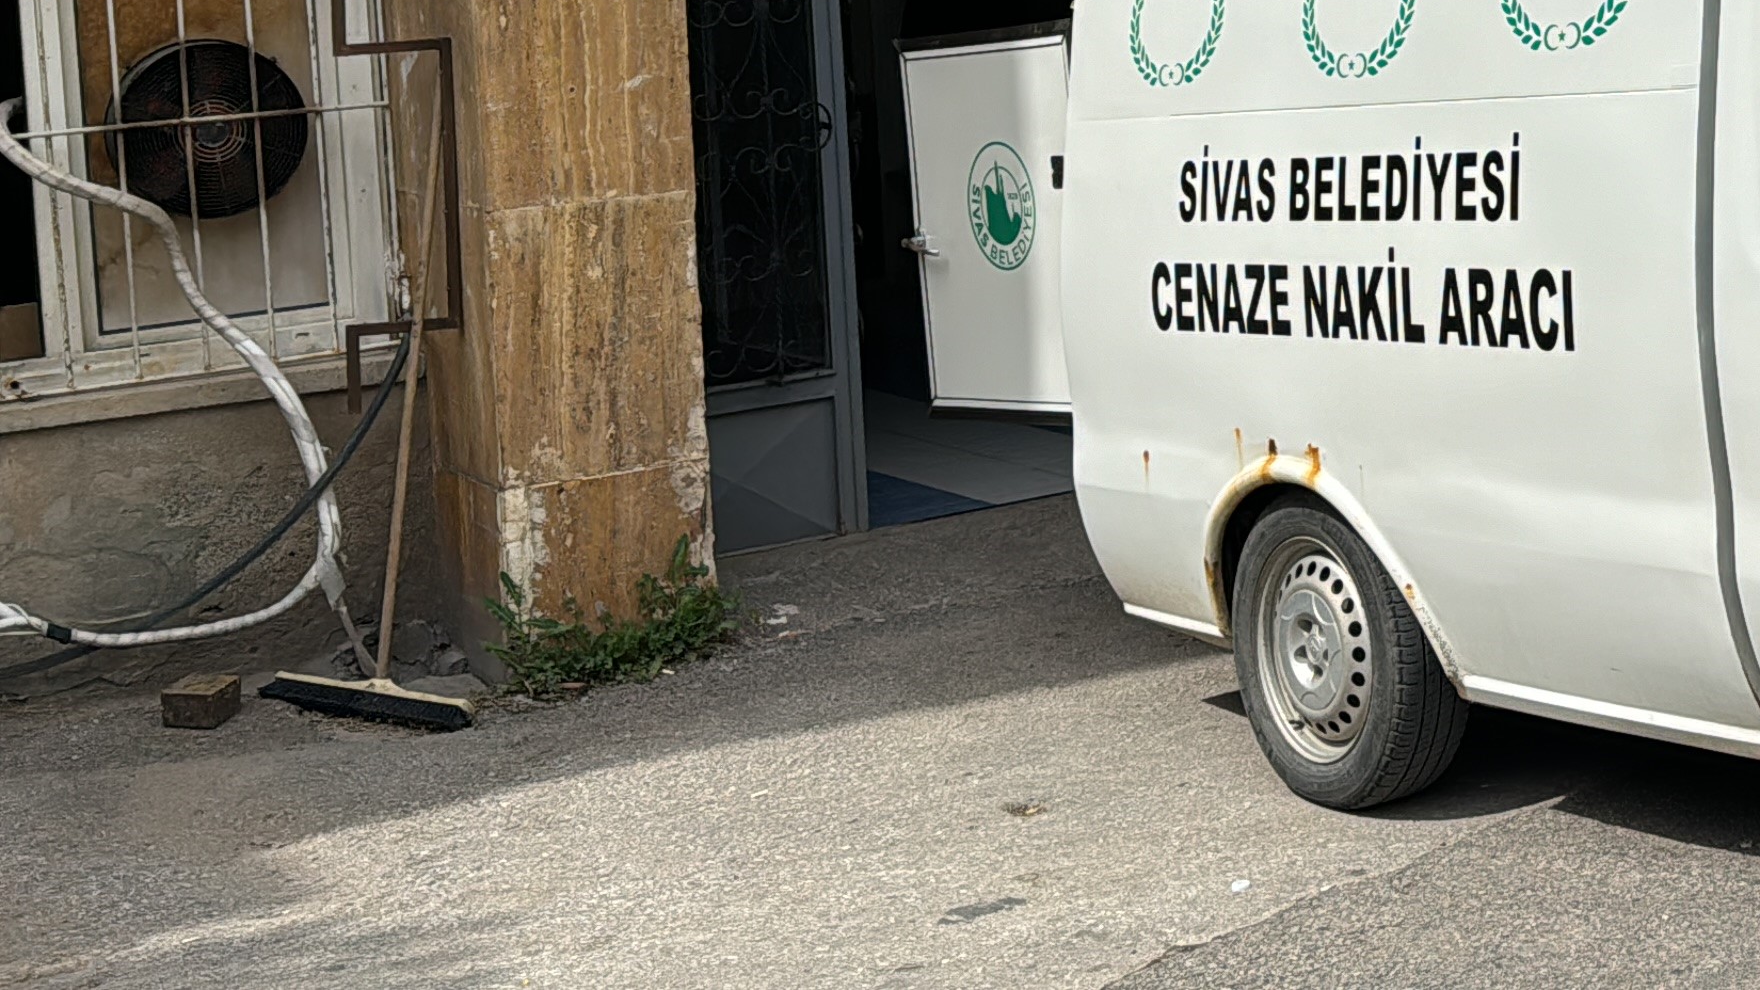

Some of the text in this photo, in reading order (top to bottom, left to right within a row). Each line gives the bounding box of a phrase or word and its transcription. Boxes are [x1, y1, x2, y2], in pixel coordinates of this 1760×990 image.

[1178, 132, 1521, 223] SİVAS BELEDİYESİ
[1151, 247, 1576, 352] CENAZE NAKİL ARACI
